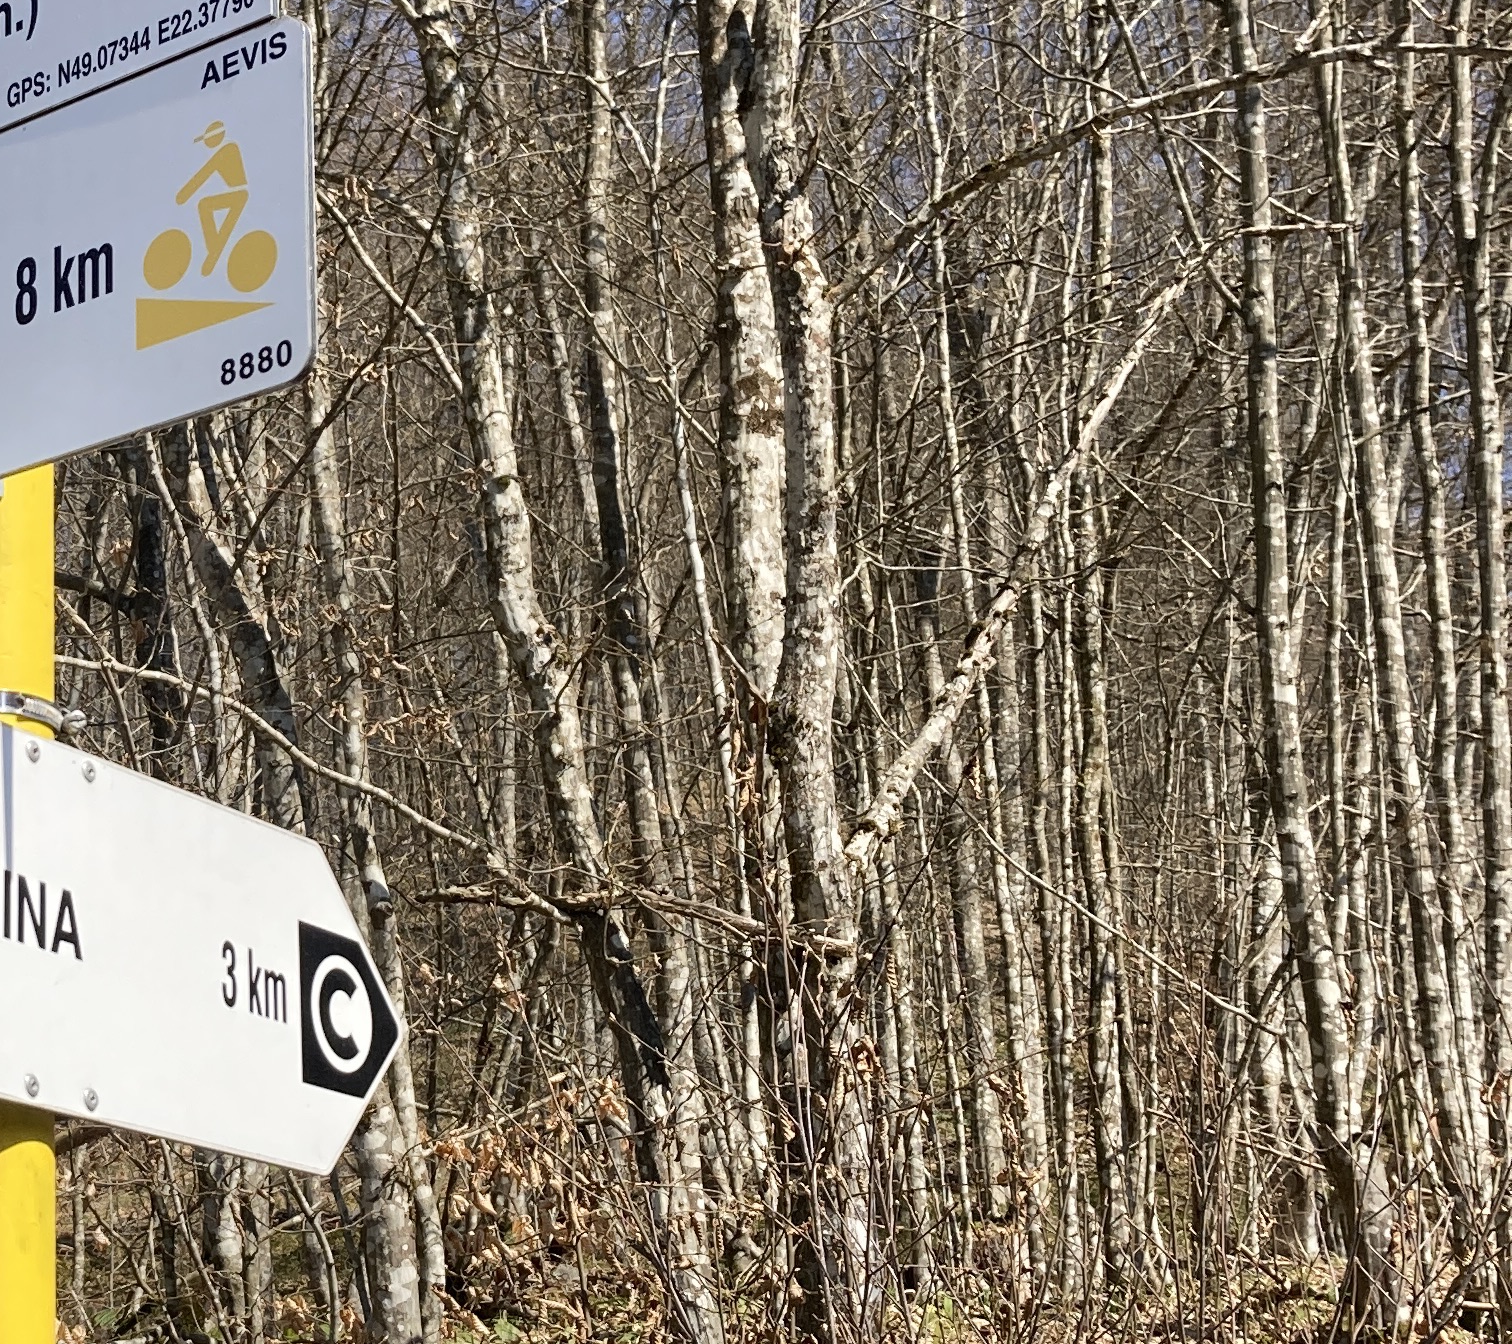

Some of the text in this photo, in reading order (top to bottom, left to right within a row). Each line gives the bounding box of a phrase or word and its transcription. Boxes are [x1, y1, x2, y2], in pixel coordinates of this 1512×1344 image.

[6, 71, 52, 108] GPS:
[57, 26, 151, 88] N49.07344
[200, 31, 288, 90] AEVIS
[14, 242, 115, 325] 8 km
[220, 338, 294, 386] 8880
[220, 940, 288, 1025] 3 km
